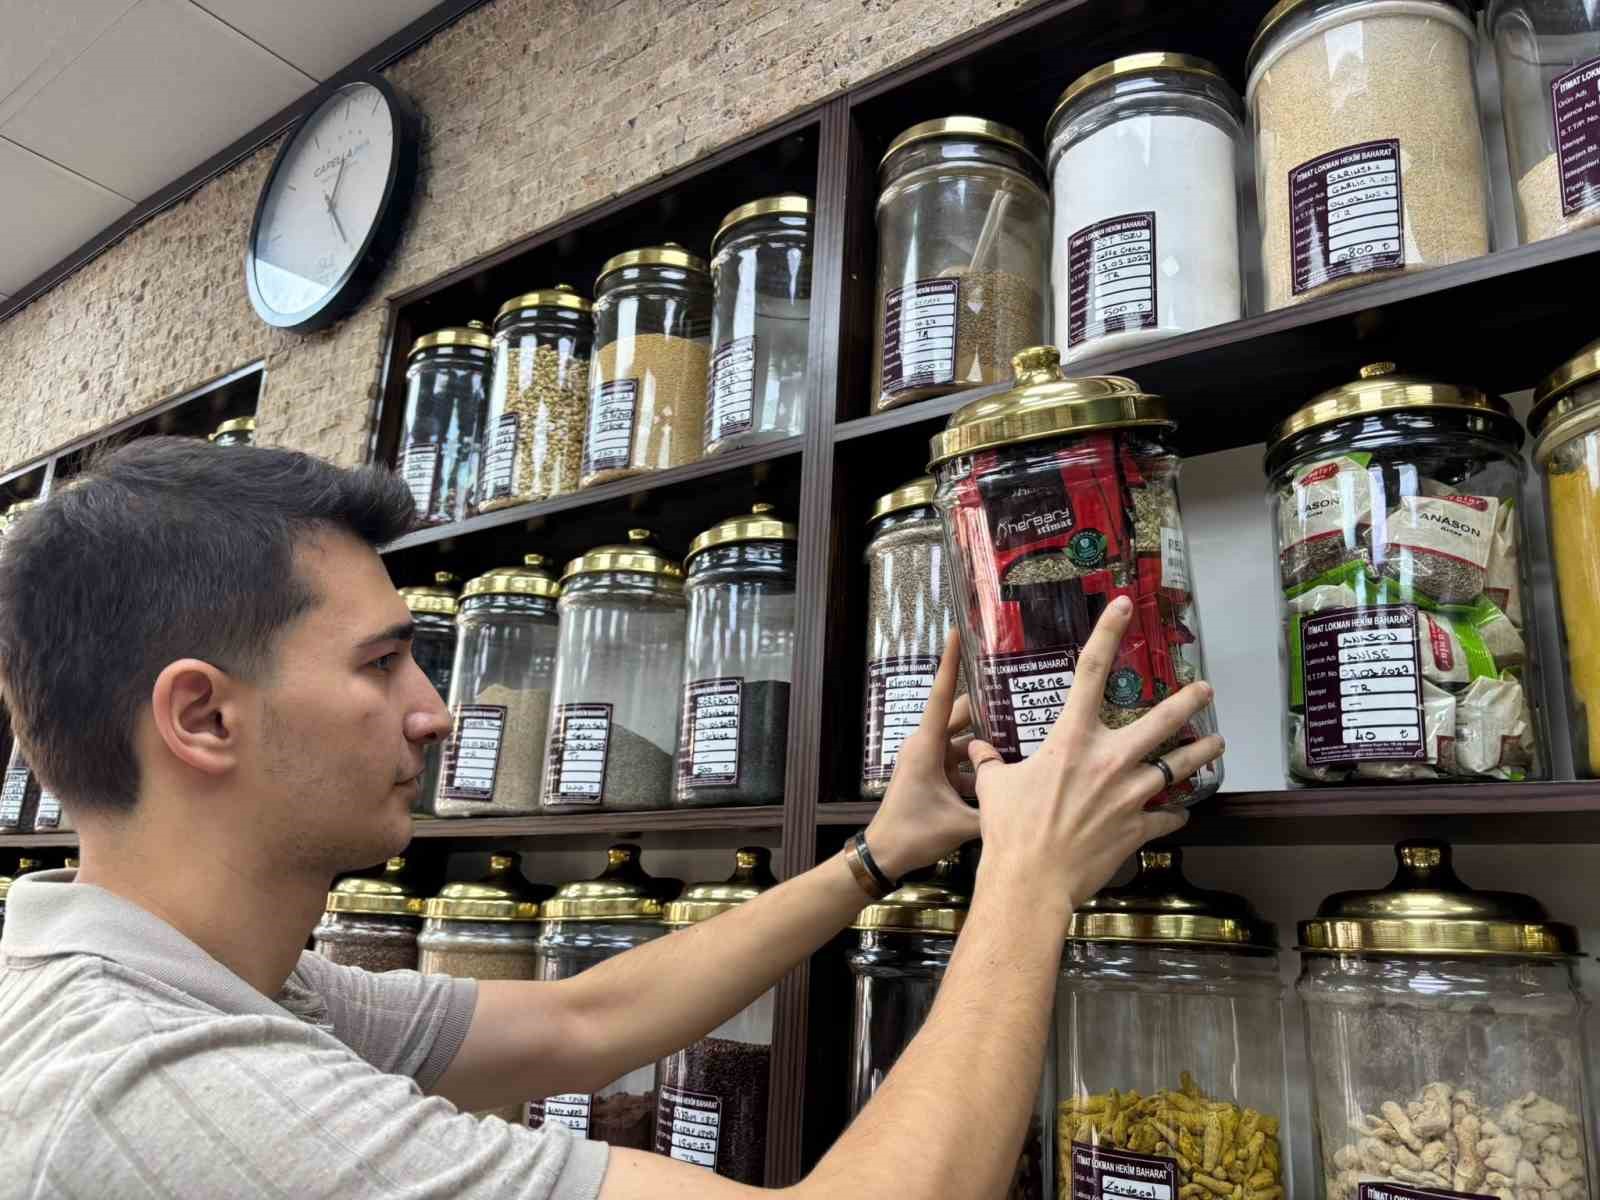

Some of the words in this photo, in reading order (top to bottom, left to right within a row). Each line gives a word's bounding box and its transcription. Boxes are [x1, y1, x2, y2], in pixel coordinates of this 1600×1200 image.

[1419, 513, 1481, 537] ANASON
[1375, 615, 1409, 628] BAHARAT
[1039, 658, 1070, 671] BAHARAT
[1021, 691, 1062, 706] Fennel
[1136, 1167, 1168, 1181] BAHARAT
